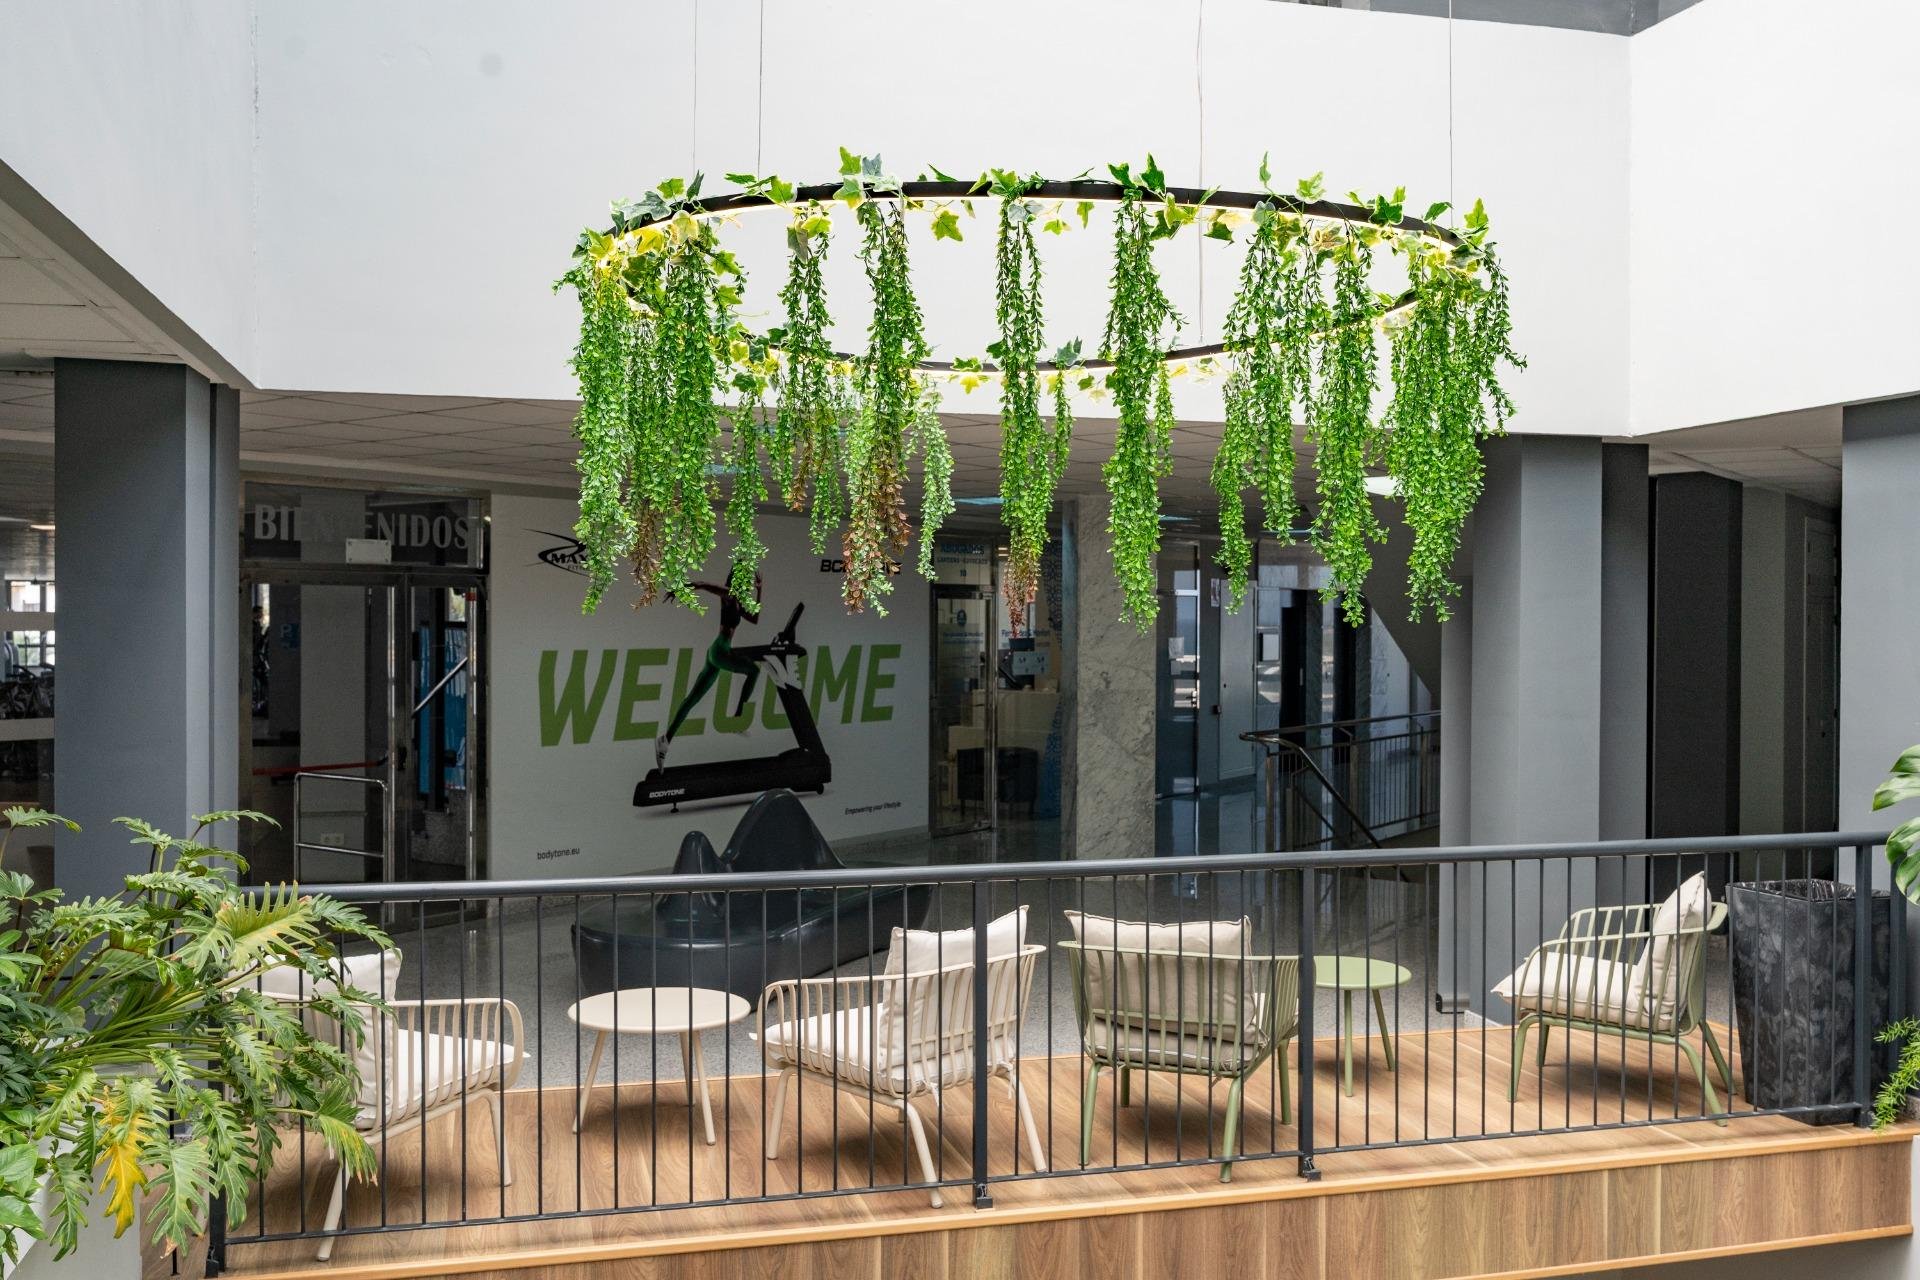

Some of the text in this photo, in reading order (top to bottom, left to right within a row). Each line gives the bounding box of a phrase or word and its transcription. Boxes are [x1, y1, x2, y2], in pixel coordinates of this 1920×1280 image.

[254, 503, 470, 549] BIENIDOS
[538, 643, 902, 748] WELCOME
[648, 788, 686, 799] BODYTONE
[536, 847, 581, 861] bodytone.eu
